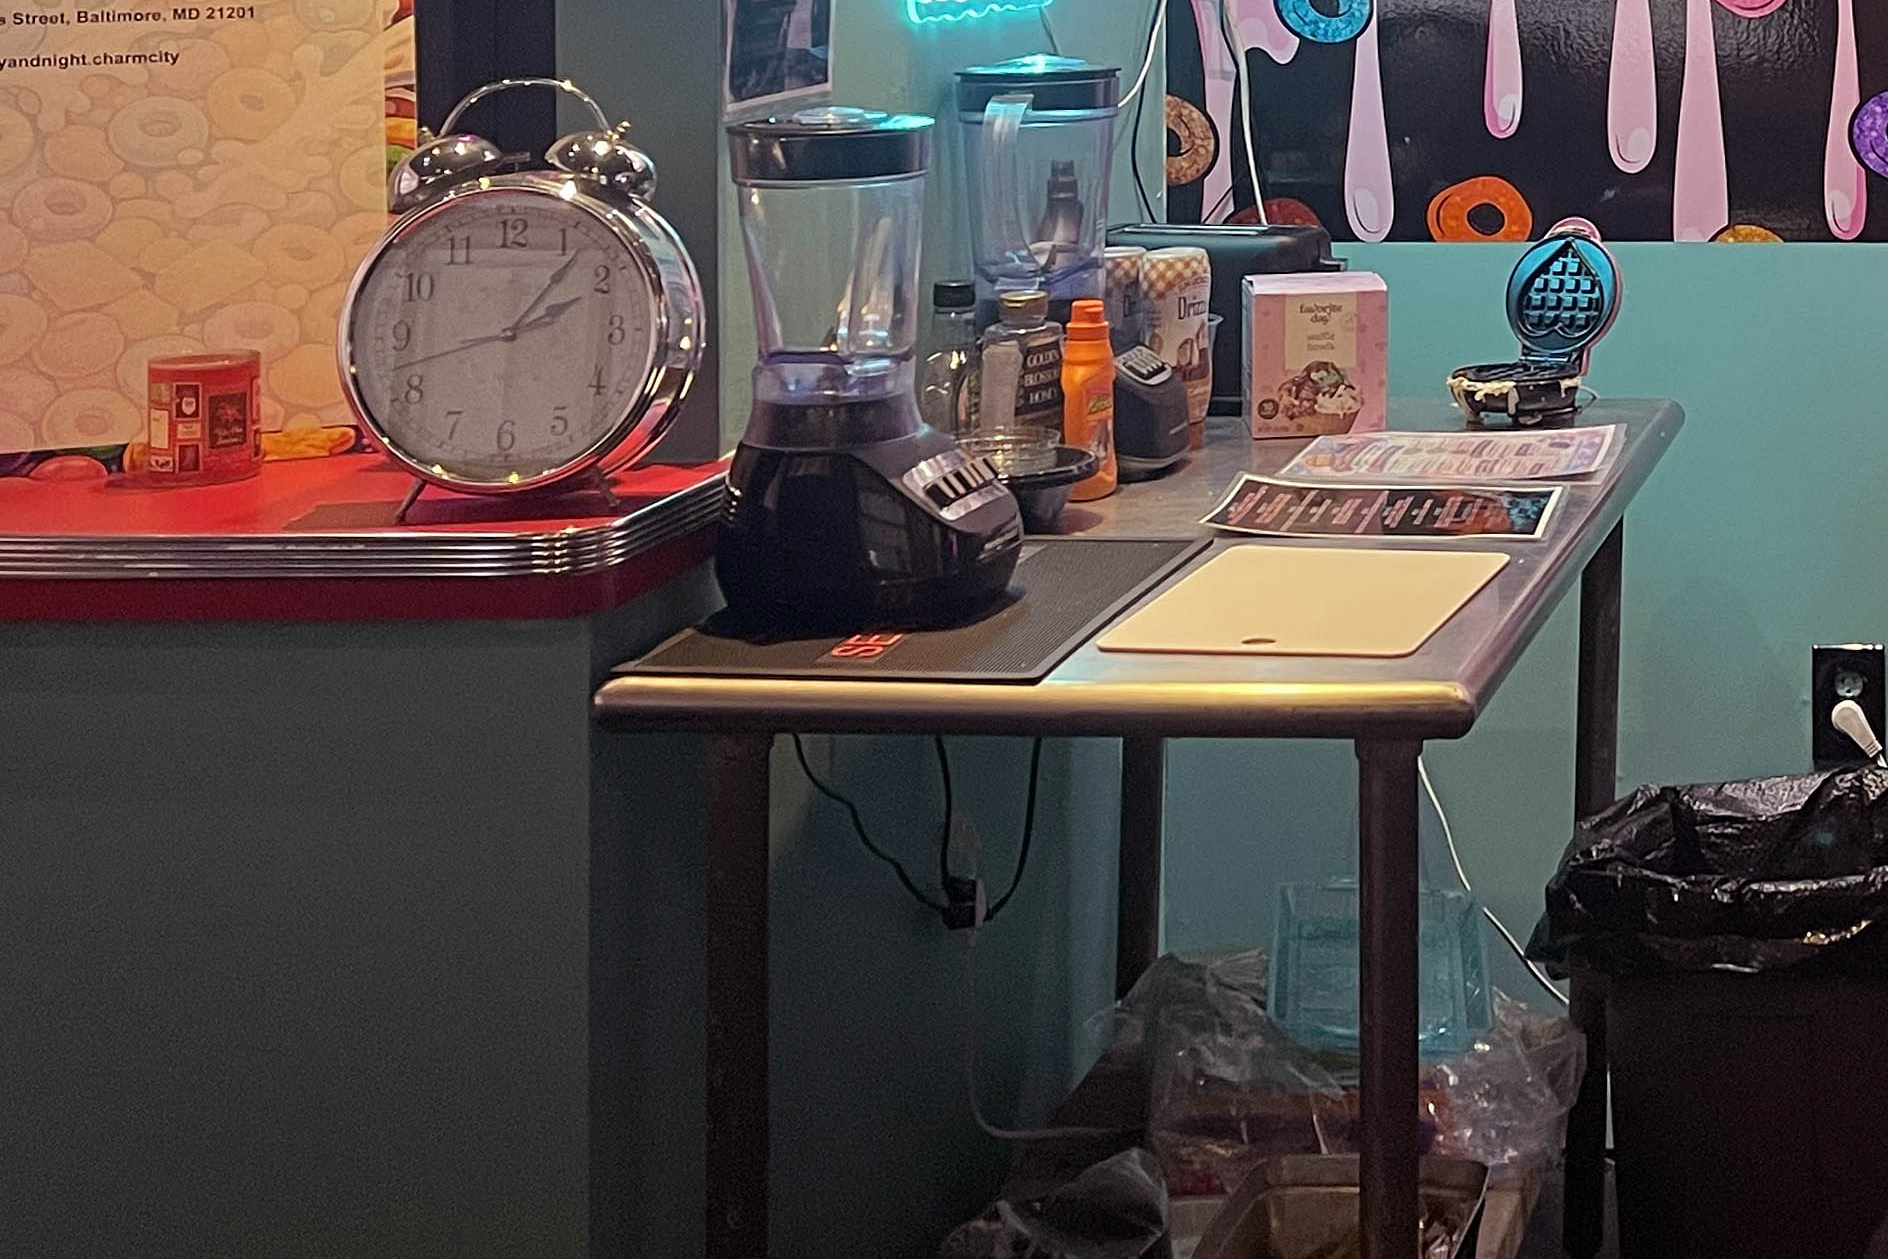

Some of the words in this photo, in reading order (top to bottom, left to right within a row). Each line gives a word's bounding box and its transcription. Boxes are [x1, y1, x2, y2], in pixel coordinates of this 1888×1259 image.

[172, 8, 201, 21] MD
[205, 6, 255, 20] 21201
[499, 218, 529, 249] 12
[558, 228, 569, 256] 1
[446, 236, 471, 266] 11
[405, 272, 435, 303] 10
[593, 265, 610, 294] 2
[391, 322, 411, 352] 9
[608, 315, 626, 344] 3
[406, 374, 424, 404] 8
[587, 367, 607, 397] 4
[445, 410, 464, 439] 7
[550, 406, 569, 435] 5
[496, 421, 516, 452] 6
